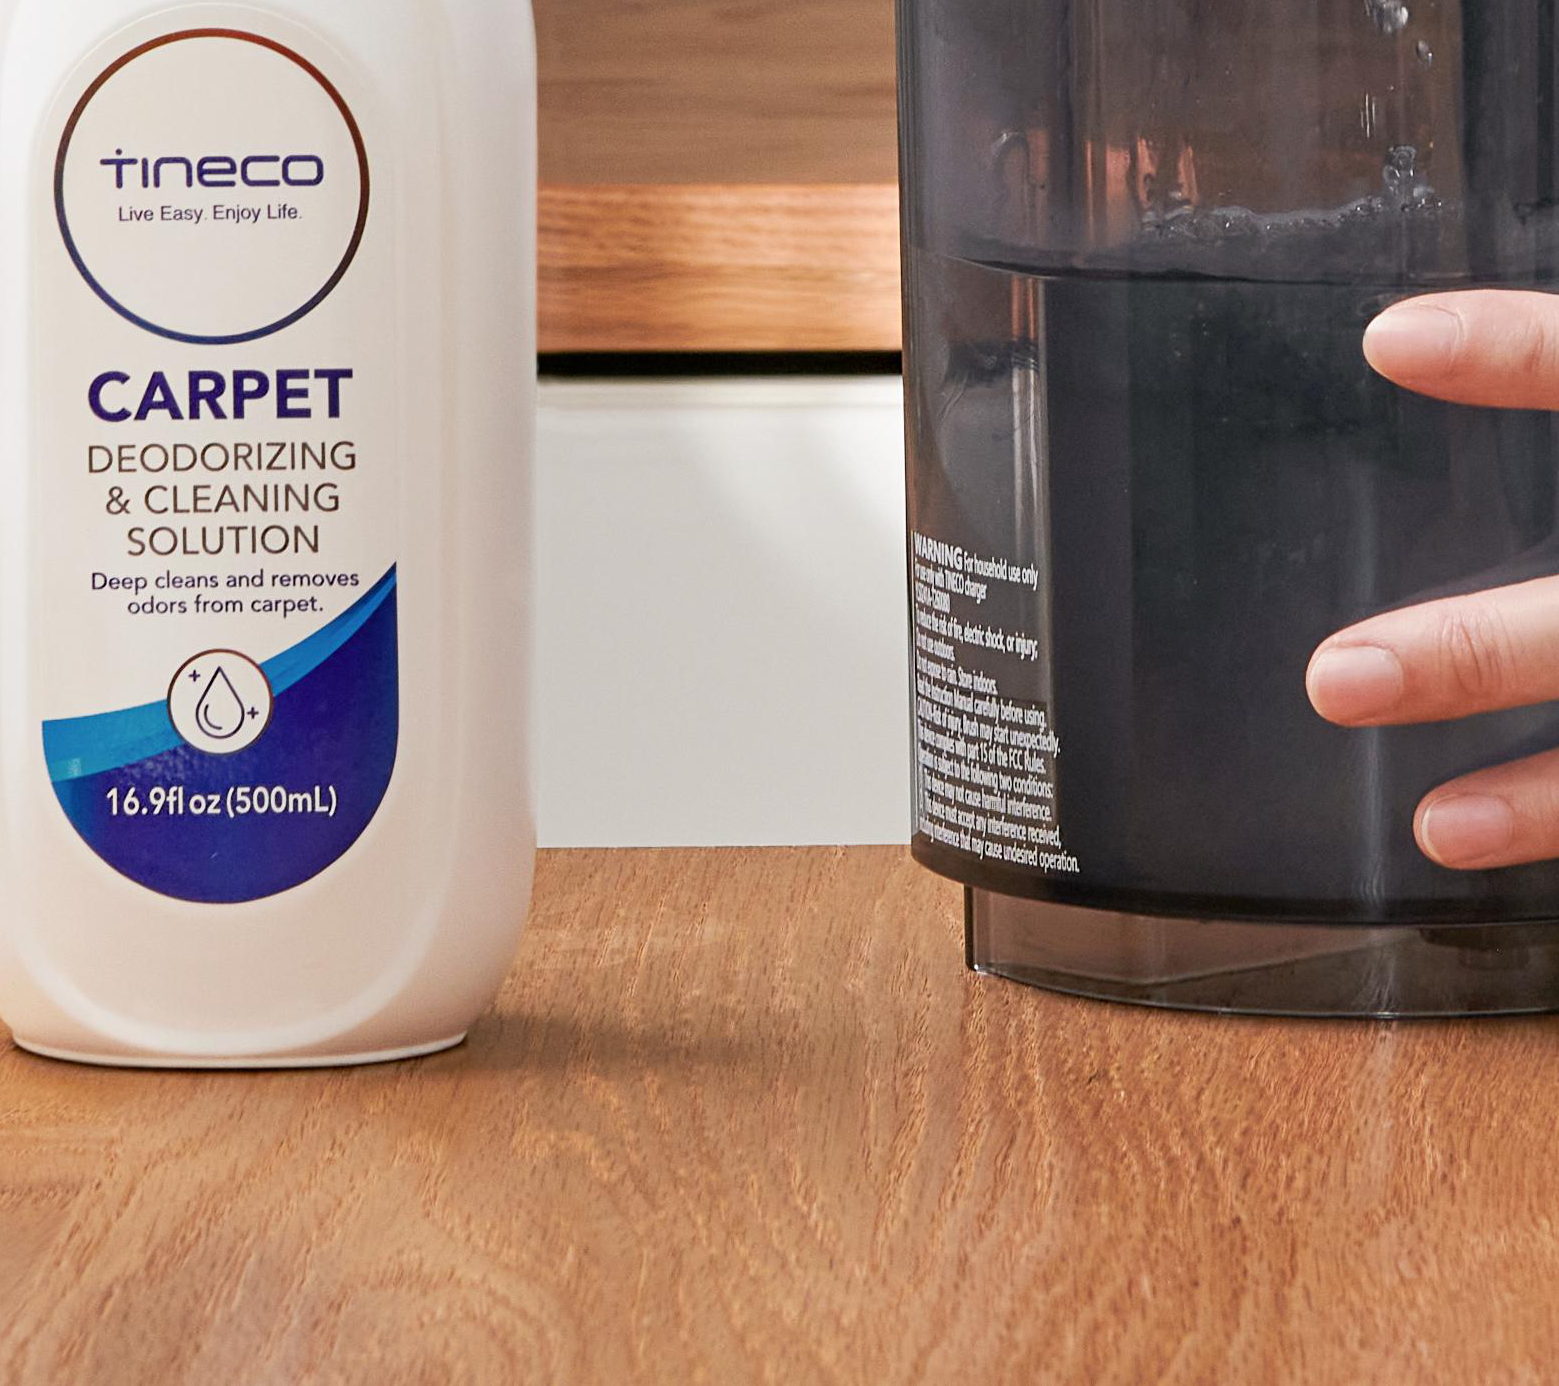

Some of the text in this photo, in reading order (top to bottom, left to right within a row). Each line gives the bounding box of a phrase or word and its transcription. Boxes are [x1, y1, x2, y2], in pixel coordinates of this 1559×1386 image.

[118, 203, 302, 224] Live Easy. Enjoy Life.
[88, 368, 353, 423] CARPET
[88, 441, 356, 473] DEODORIZING
[105, 483, 339, 515] & CLEANING
[127, 525, 319, 556] SOLUTION
[914, 531, 1038, 591] WARNING For household use only
[91, 568, 359, 595] Deep cleans and removes
[945, 569, 964, 595] TINECO
[964, 575, 988, 604] charger
[127, 594, 323, 618] odors from carpet.
[964, 621, 985, 647] electric
[985, 626, 1005, 654] shock,
[1007, 635, 1015, 652] or
[958, 666, 973, 690] Store
[974, 695, 999, 724] carefully
[1000, 698, 1023, 724] before
[1024, 704, 1047, 733] using.
[963, 714, 979, 738] Brush
[979, 723, 994, 747] may
[994, 724, 1009, 745] start
[1009, 729, 1060, 759] unexpectedly.
[967, 742, 980, 764] part
[980, 742, 988, 764] 15
[988, 743, 996, 766] of
[996, 745, 1008, 768] the
[1009, 747, 1023, 770] FCC
[1024, 746, 1047, 774] Rules.
[970, 762, 998, 794] following
[999, 771, 1012, 791] two
[1013, 774, 1053, 798] conditions:
[189, 794, 221, 815] oz
[226, 784, 337, 819] (500mL)
[964, 789, 981, 808] cause
[981, 787, 1006, 814] harmful
[1007, 793, 1052, 822] interference.
[958, 810, 975, 834] accept
[975, 815, 987, 838] any
[987, 812, 1027, 841] interference
[1028, 823, 1061, 850] received,
[960, 828, 971, 851] that
[971, 837, 984, 860] may
[985, 840, 1003, 860] cause
[1003, 841, 1038, 867] undesired
[1039, 849, 1080, 874] operation.
